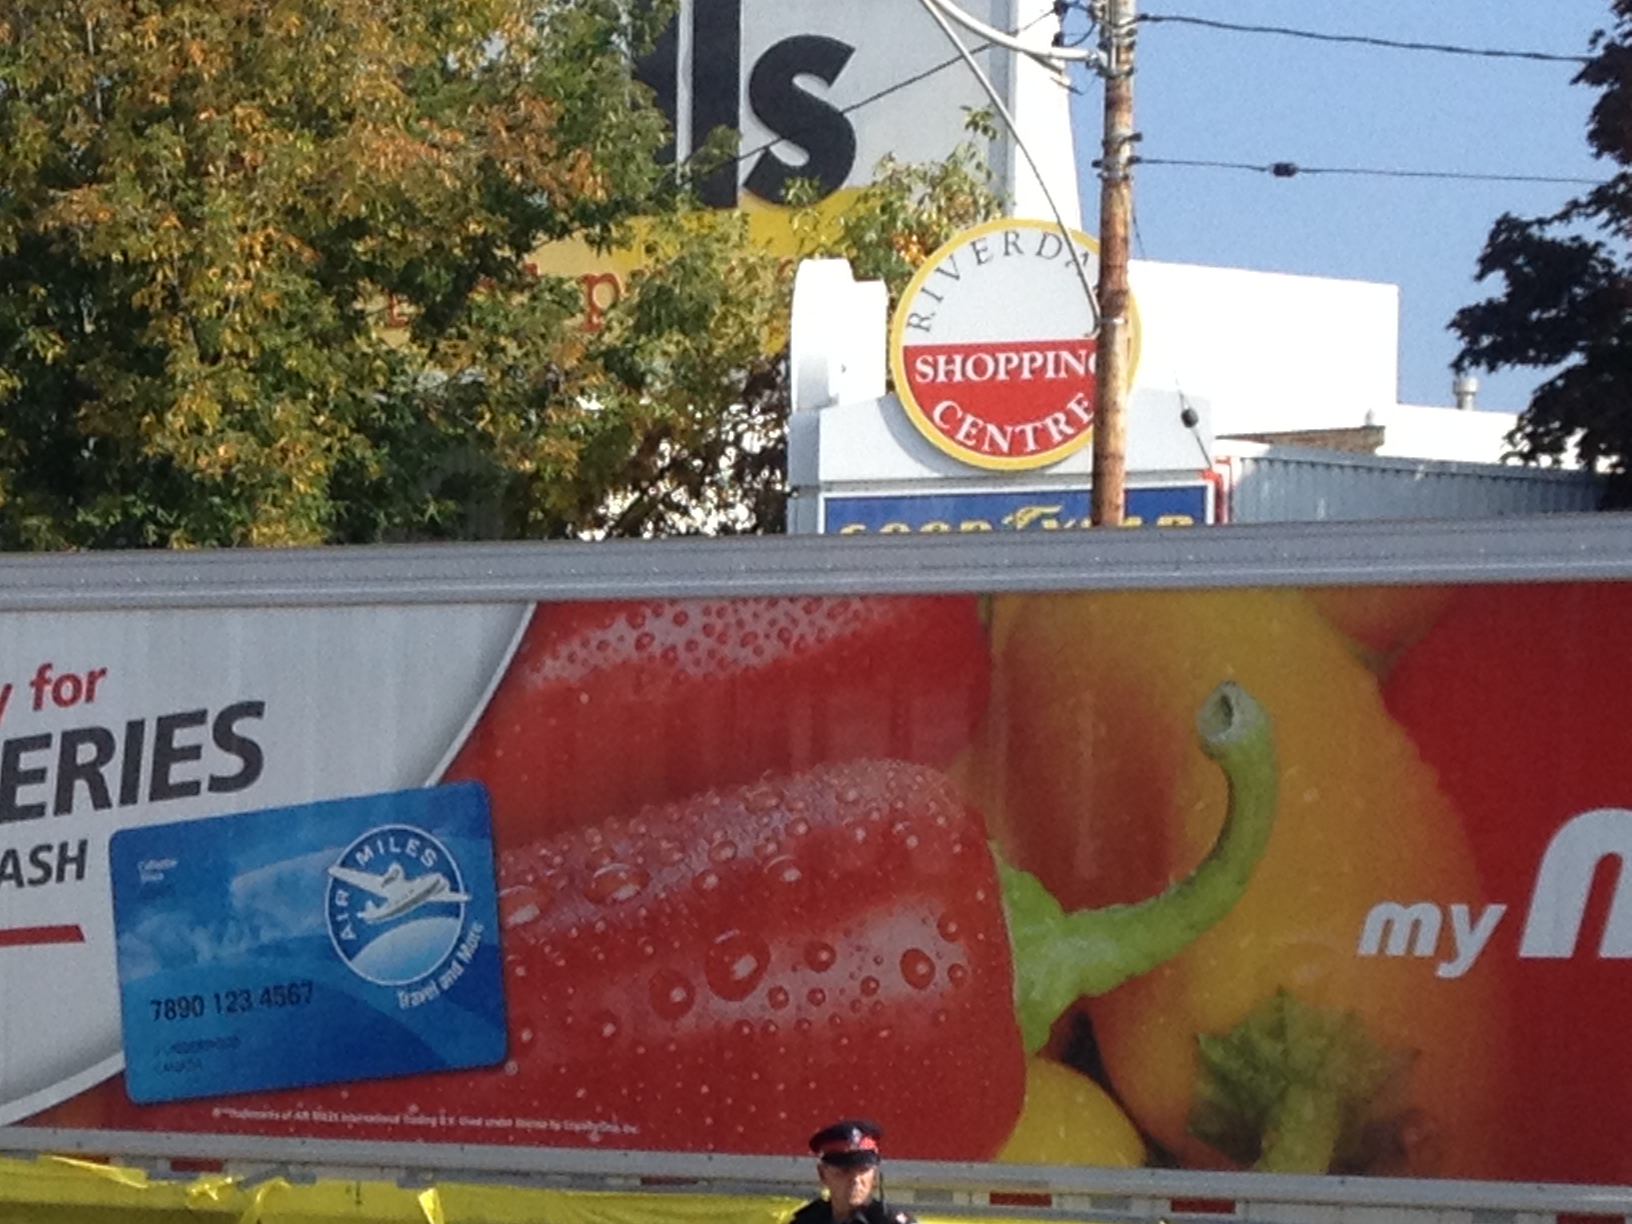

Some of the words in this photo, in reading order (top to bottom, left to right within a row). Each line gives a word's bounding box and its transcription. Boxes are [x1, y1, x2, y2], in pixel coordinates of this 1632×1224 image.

[906, 229, 1099, 333] RIVERDA
[932, 392, 1094, 453] CENTRE
[28, 662, 107, 714] for
[355, 837, 438, 868] MILES
[1358, 901, 1508, 978] my
[150, 994, 205, 1022] 7890
[214, 988, 254, 1015] 123
